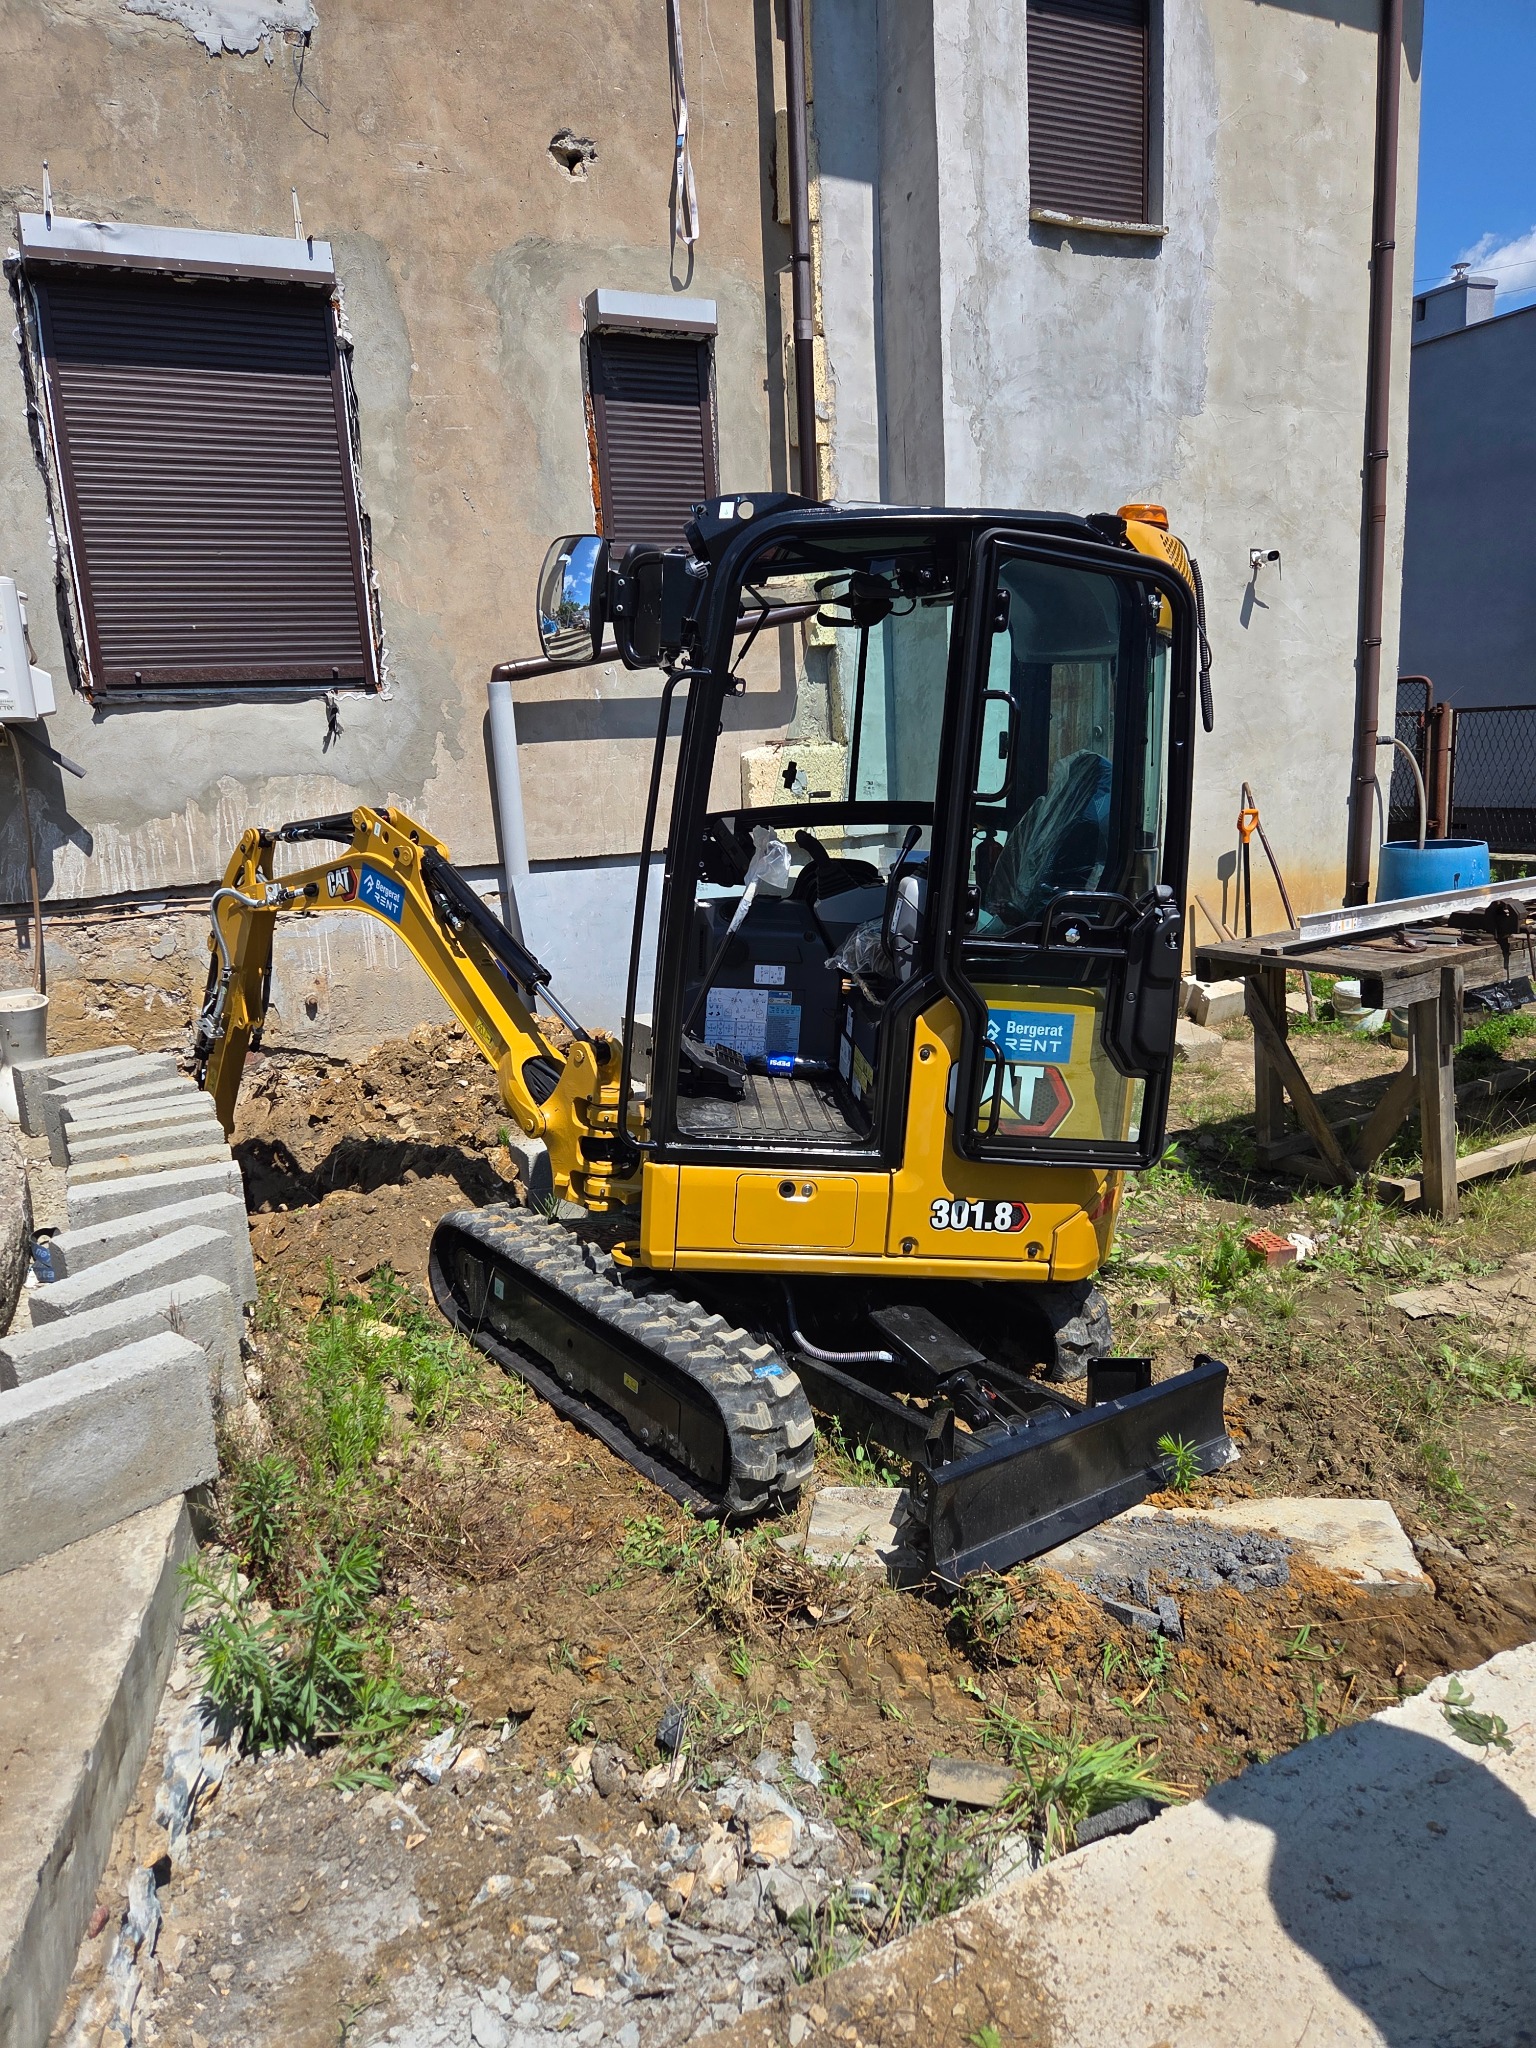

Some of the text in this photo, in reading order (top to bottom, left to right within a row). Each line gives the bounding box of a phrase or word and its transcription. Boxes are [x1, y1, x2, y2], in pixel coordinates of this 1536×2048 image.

[327, 867, 350, 897] CAT
[375, 879, 400, 903] Bergerat
[374, 892, 399, 914] RENT
[1006, 1020, 1064, 1038] Bergerat
[1005, 1038, 1062, 1053] RENT
[769, 1059, 791, 1067] PEPSI
[948, 1060, 1045, 1120] AT
[931, 1199, 1013, 1231] 301.8
